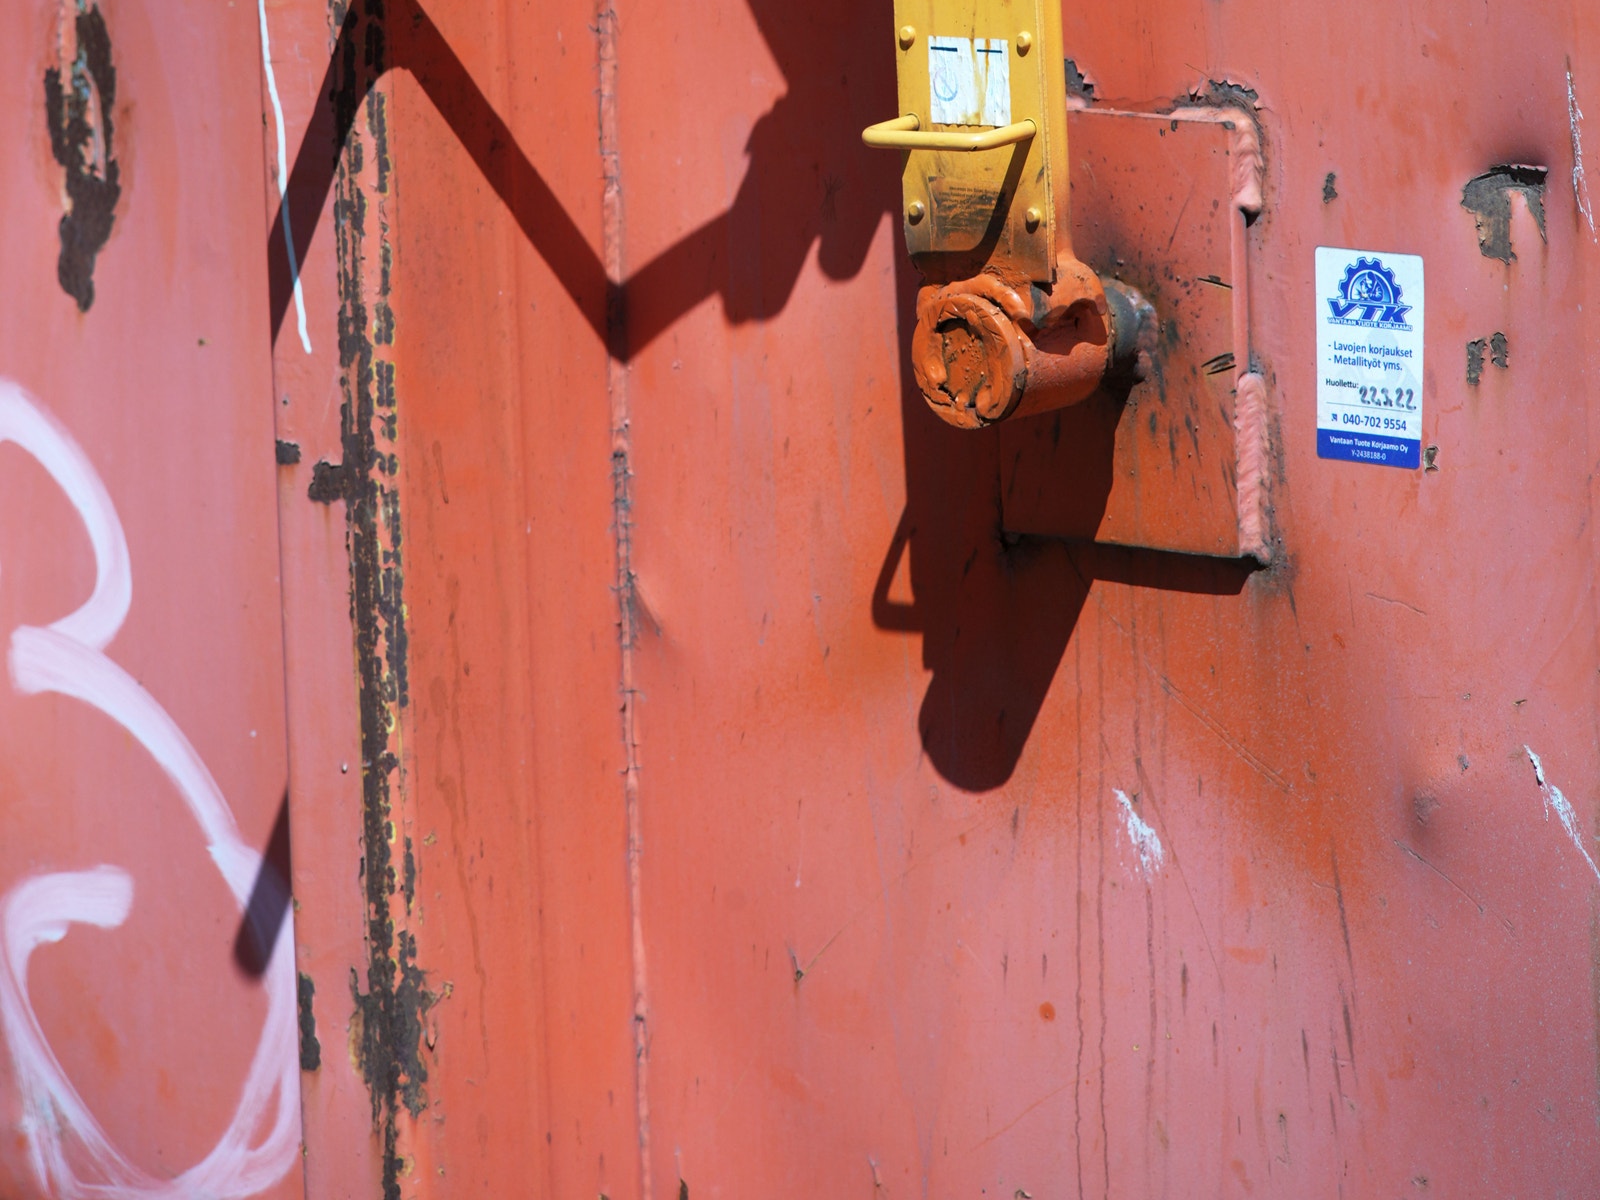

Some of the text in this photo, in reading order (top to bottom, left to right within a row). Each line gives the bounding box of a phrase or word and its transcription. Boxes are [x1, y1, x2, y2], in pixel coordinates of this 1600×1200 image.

[1326, 298, 1413, 325] VTK
[1327, 317, 1413, 332] VANTAAN TUOTE KORJAAMO
[1333, 341, 1367, 354] Lavojen
[1368, 344, 1413, 358] korjaukset
[1333, 354, 1381, 369] Metallityöt
[1382, 361, 1403, 371] yms.
[1326, 378, 1359, 389] Huollettu:
[1342, 413, 1407, 432] 040-702 9554
[1329, 435, 1409, 454] Vantaan Tuote Korjaamo Oy
